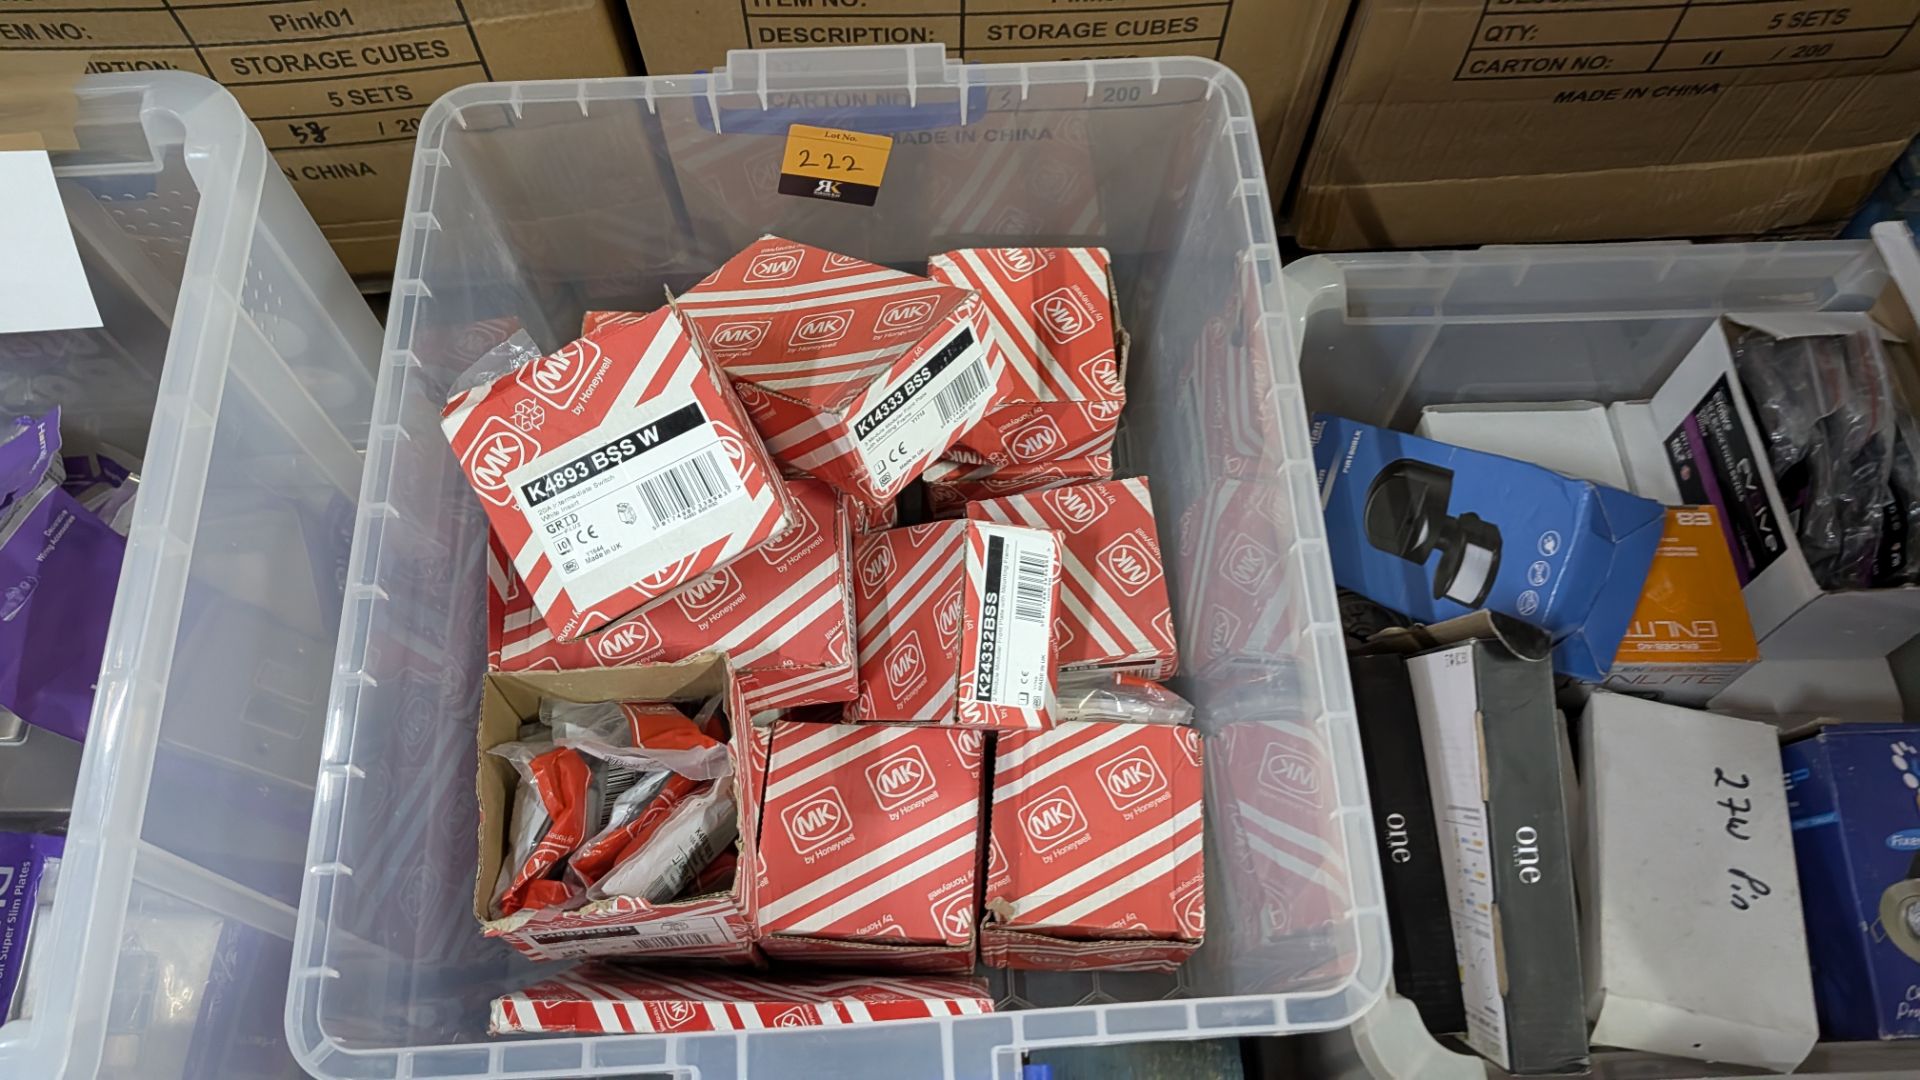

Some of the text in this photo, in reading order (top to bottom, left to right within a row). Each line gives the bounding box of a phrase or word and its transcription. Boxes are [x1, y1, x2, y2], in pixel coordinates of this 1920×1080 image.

[40, 23, 93, 41] NO:
[268, 7, 356, 33] Pink01
[986, 16, 1200, 42] STORAGE CUBES
[1484, 24, 1539, 42] QTY:
[1767, 8, 1852, 30] 5 SETS
[758, 27, 935, 44] DESCRIPTION:
[1791, 43, 1835, 59] 200
[230, 39, 451, 76] STORAGE CUBES
[1468, 55, 1615, 75] CARTON NO:
[327, 84, 414, 108] 5 SETS
[1102, 85, 1142, 103] 200
[1552, 82, 1722, 104] MADE IN CHINA
[823, 130, 858, 143] Lot No.
[955, 129, 977, 144] IN
[983, 127, 1054, 143] CHINA
[300, 160, 378, 182] CHINA
[798, 148, 865, 172] 222
[802, 319, 839, 335] MK
[886, 305, 925, 323] MK
[1045, 299, 1080, 333] MK
[717, 328, 754, 344] MK
[534, 346, 580, 390] MK
[571, 356, 614, 417] by Honeywell
[857, 390, 906, 437] K14333
[903, 366, 933, 397] BSS
[1018, 429, 1052, 456] MK
[474, 434, 520, 487] MK
[526, 425, 661, 503] K4893 BSS W
[1058, 485, 1093, 520] MK
[546, 513, 579, 535] GRID
[576, 524, 600, 545] CE
[584, 551, 604, 565] Made
[610, 542, 623, 553] UK
[776, 564, 788, 575] by
[787, 535, 825, 565] Honeywell
[864, 549, 890, 583] MK
[1112, 546, 1148, 583] MK
[686, 570, 727, 606] MK
[697, 592, 747, 632] by Honeywell
[603, 625, 645, 657] MK
[977, 591, 998, 698] K24332BSS
[891, 647, 918, 684] MK
[879, 761, 923, 793] MK
[1110, 761, 1152, 793] MK
[796, 803, 838, 836] MK
[888, 790, 940, 822] by Honeywell
[1030, 801, 1072, 836] MK
[1122, 790, 1172, 822] by Honeywell
[803, 832, 856, 865] by Honeywell
[1041, 832, 1093, 865] by Honeywell
[1385, 812, 1412, 864] one
[1515, 825, 1542, 885] one
[0, 860, 32, 962] Super Slim Plates
